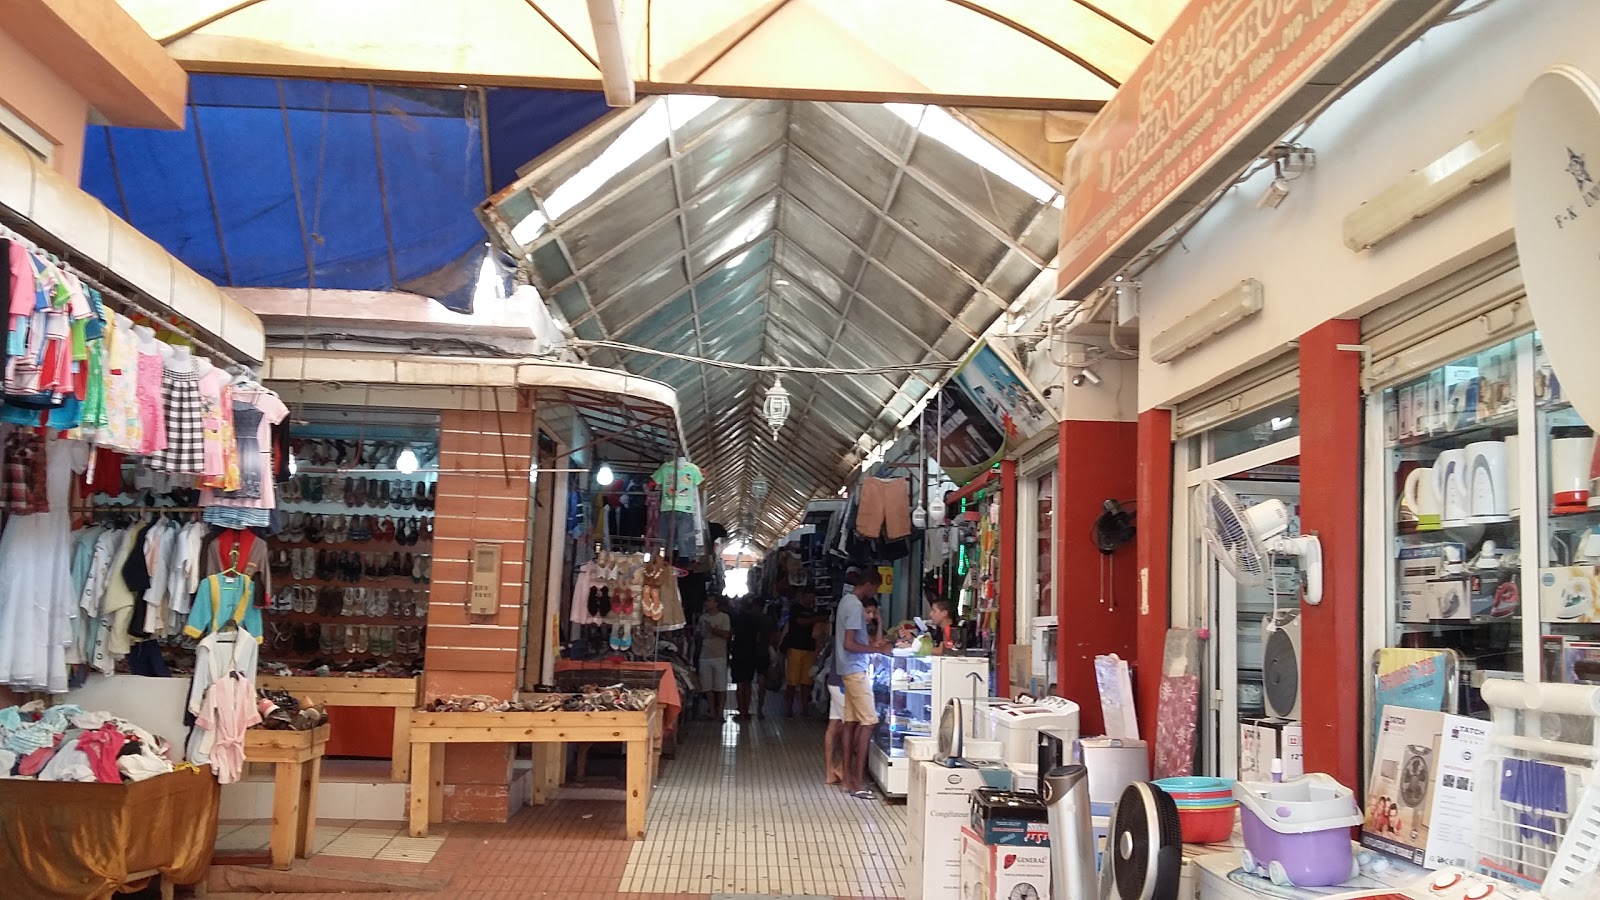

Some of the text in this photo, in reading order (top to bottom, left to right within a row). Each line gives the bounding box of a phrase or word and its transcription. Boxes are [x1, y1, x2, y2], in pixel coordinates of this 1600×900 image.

[1113, 0, 1278, 191] ALPHA ELECTRO
[1459, 725, 1485, 736] TATCH
[1017, 856, 1047, 864] GENERAL
